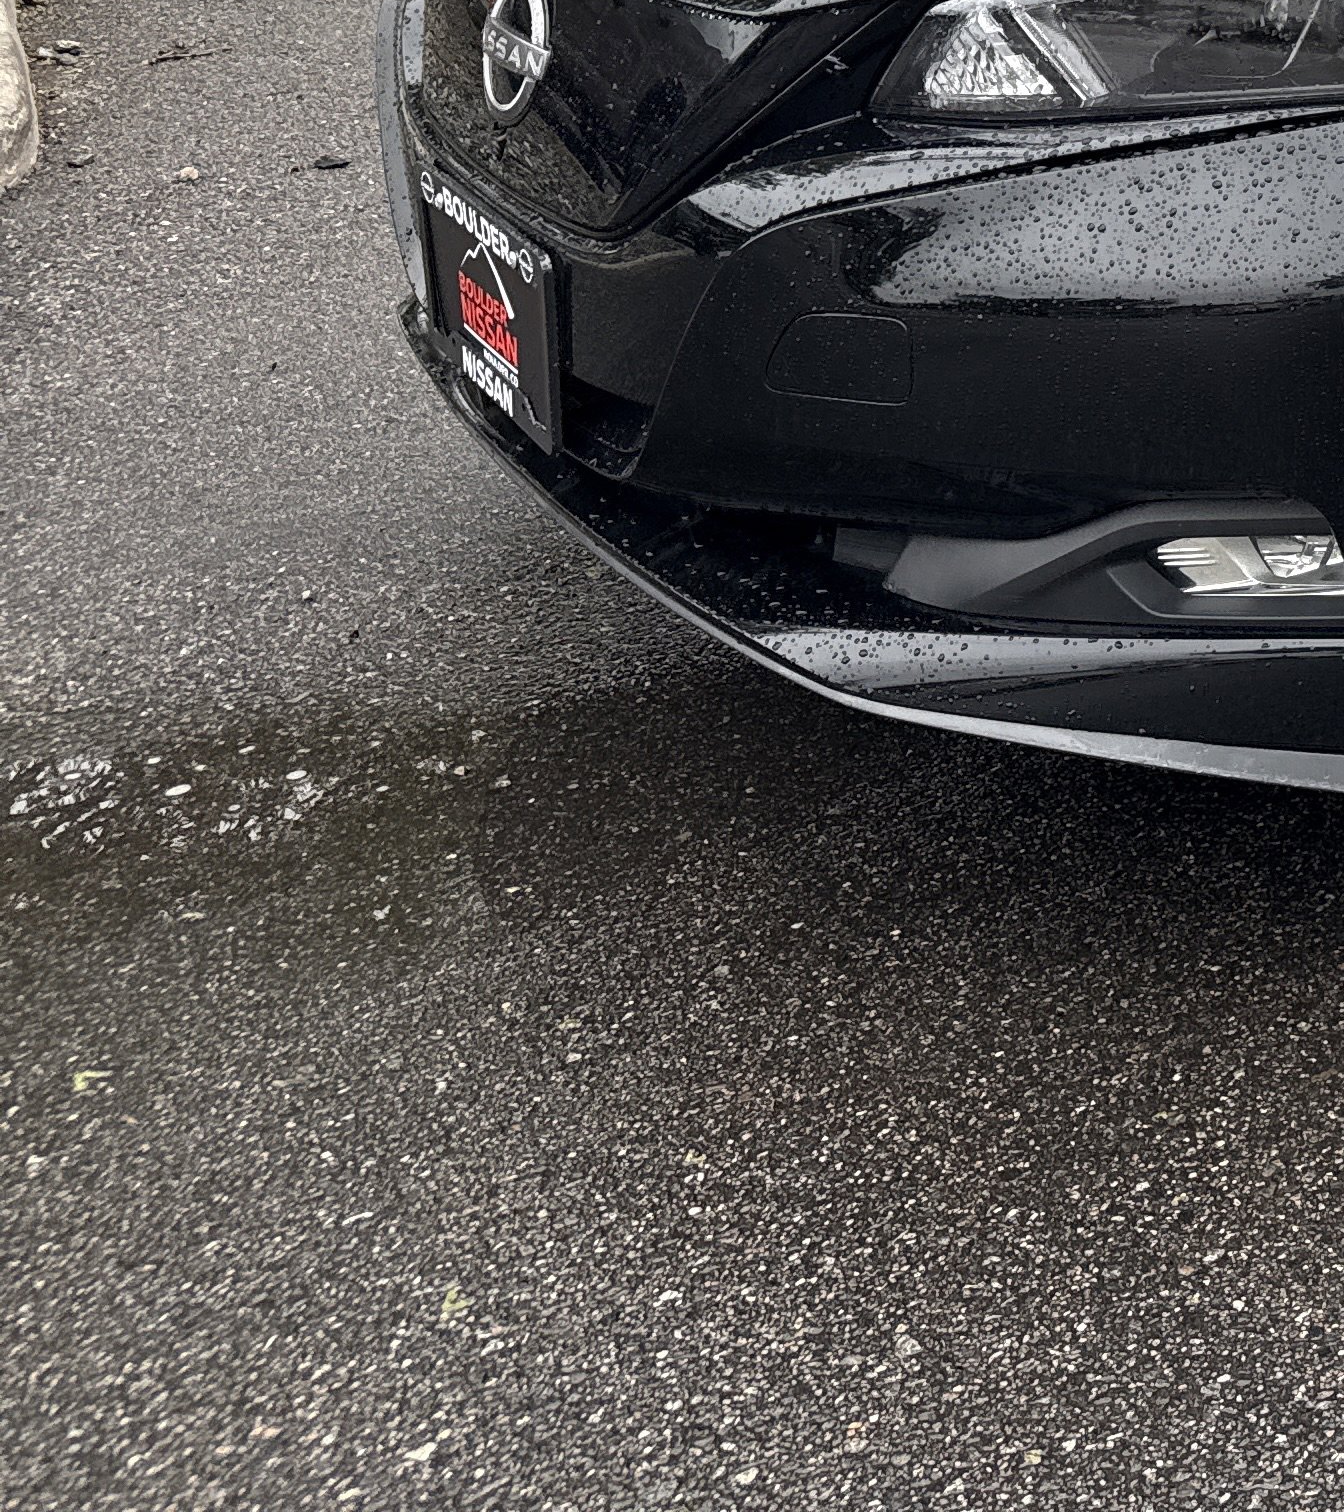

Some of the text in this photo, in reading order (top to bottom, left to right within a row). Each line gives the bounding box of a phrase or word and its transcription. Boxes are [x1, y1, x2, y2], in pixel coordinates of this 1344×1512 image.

[485, 29, 544, 78] SSAN
[442, 186, 516, 266] BOULDER
[458, 270, 508, 328] BOULDER
[460, 293, 519, 368] NISSAN
[461, 345, 514, 418] NISSAN
